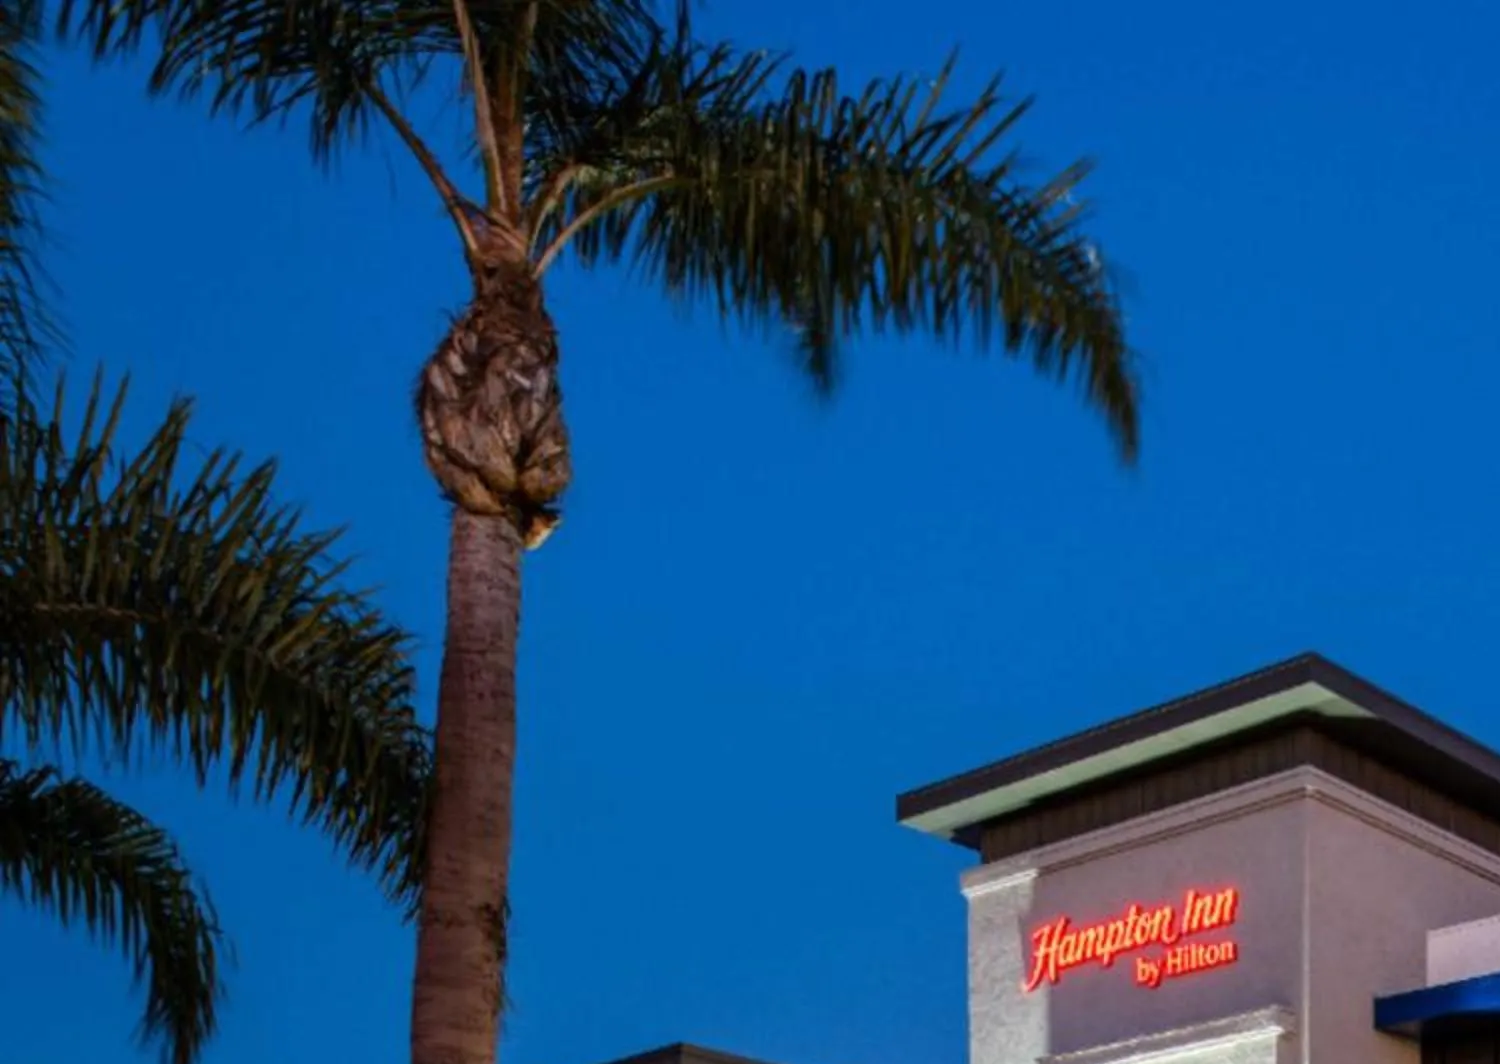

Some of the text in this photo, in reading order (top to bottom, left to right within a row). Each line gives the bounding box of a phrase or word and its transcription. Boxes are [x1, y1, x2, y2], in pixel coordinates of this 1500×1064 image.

[1023, 887, 1238, 992] Hampton Inn
[1135, 940, 1237, 987] by Hilton
